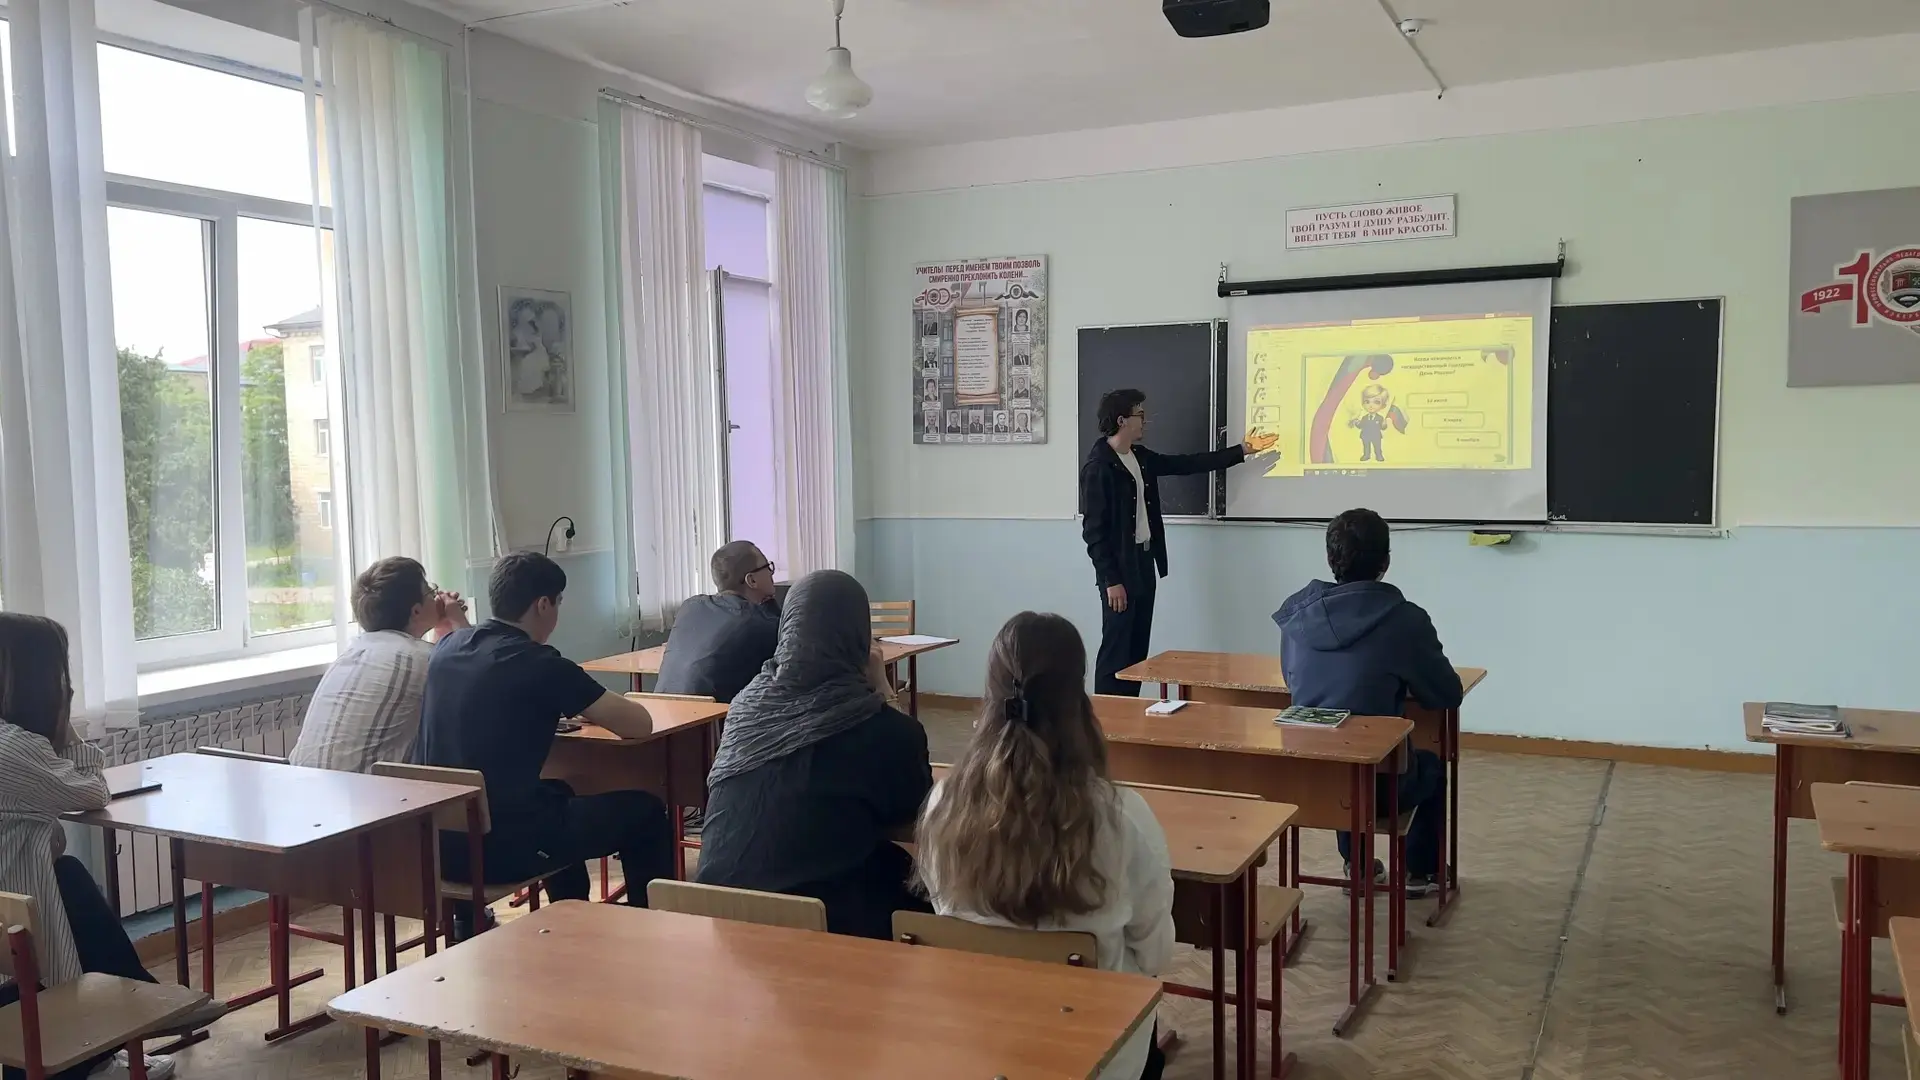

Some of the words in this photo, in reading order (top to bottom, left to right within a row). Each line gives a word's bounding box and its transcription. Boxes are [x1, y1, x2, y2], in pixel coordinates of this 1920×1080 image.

[1315, 211, 1347, 221] ПУСТЬ
[1350, 207, 1383, 218] СЛОВО
[1386, 204, 1423, 215] ЖИВОЕ
[1291, 221, 1316, 233] ТВОЙ
[1319, 220, 1350, 231] РАЗУМ
[1354, 219, 1360, 228] И
[1363, 217, 1394, 228] ДУШУ
[1294, 232, 1329, 243] ВВЕДЕТ
[1332, 231, 1356, 240] ТЕБЯ
[1363, 229, 1369, 237] В
[1372, 227, 1394, 237] МИР
[1397, 223, 1448, 235] КРАСОТЫ.
[945, 264, 965, 273] ПЕРЕД
[965, 262, 991, 272] ИМЕНЕМ
[992, 261, 1012, 270] ТВОИМ
[1012, 259, 1041, 269] ПОЗВОЛЬ
[928, 273, 960, 283] СМИРЕННО
[960, 271, 998, 282] ПРЕКЛОНИТЬ
[1813, 287, 1841, 301] 1922
